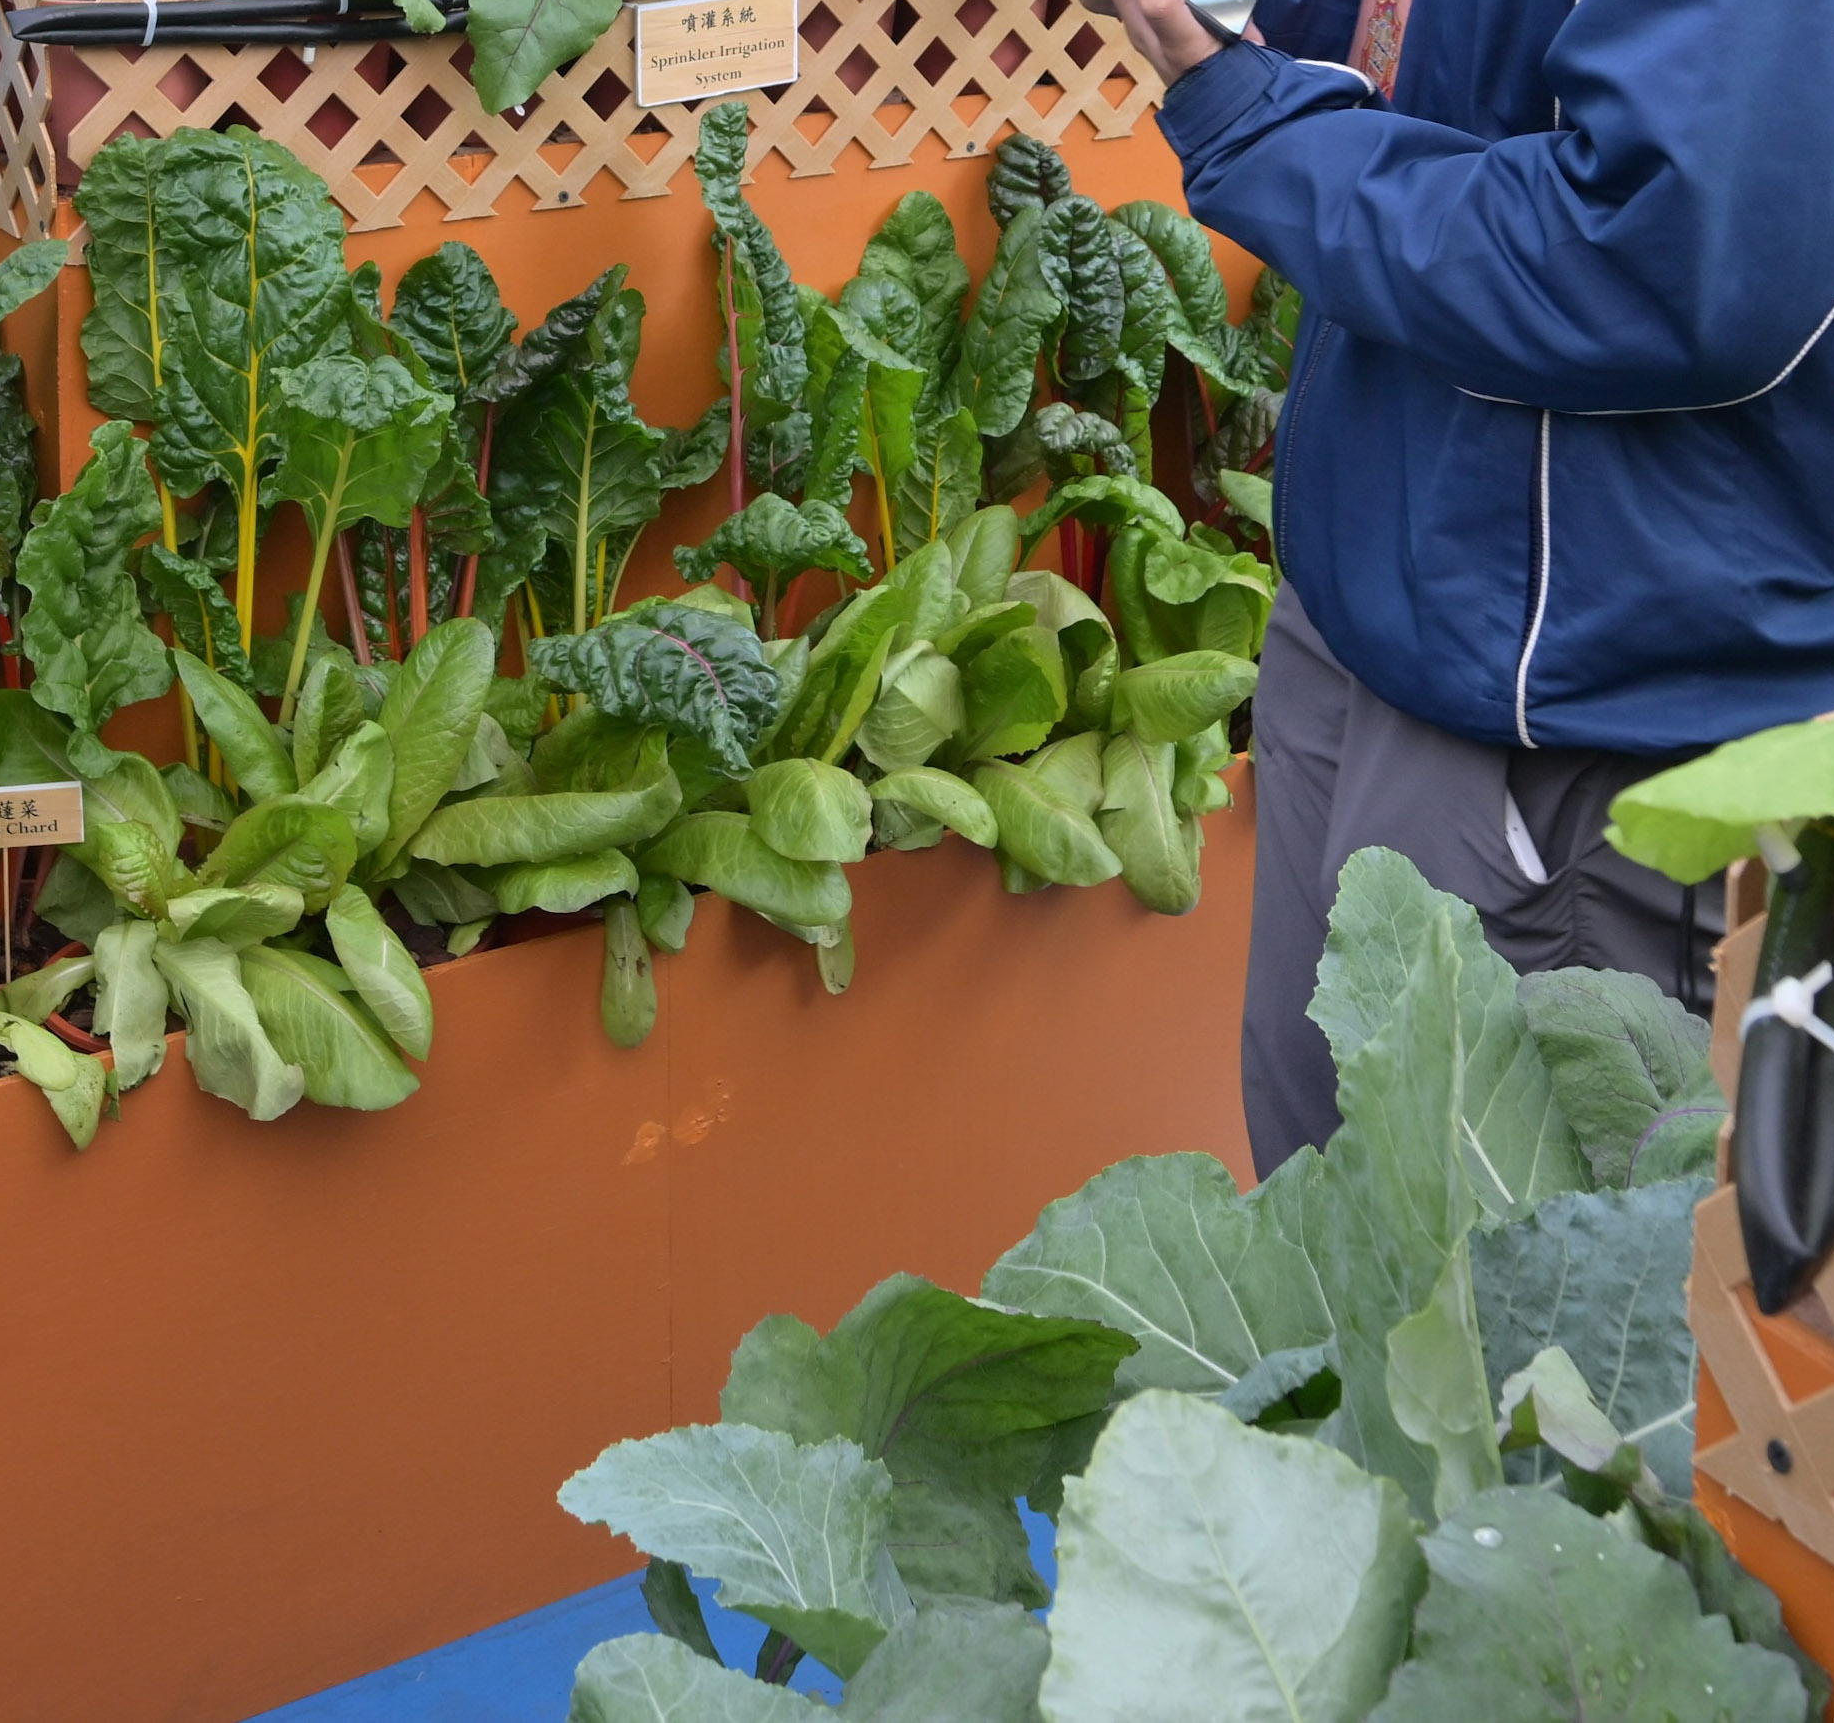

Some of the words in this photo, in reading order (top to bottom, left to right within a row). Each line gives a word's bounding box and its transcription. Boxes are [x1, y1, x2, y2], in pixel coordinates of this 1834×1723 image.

[681, 5, 757, 33] 噴灌系統
[650, 47, 716, 72] Sprinkler
[720, 38, 785, 59] Irrigation
[695, 69, 742, 88] System
[6, 819, 59, 835] Chard
